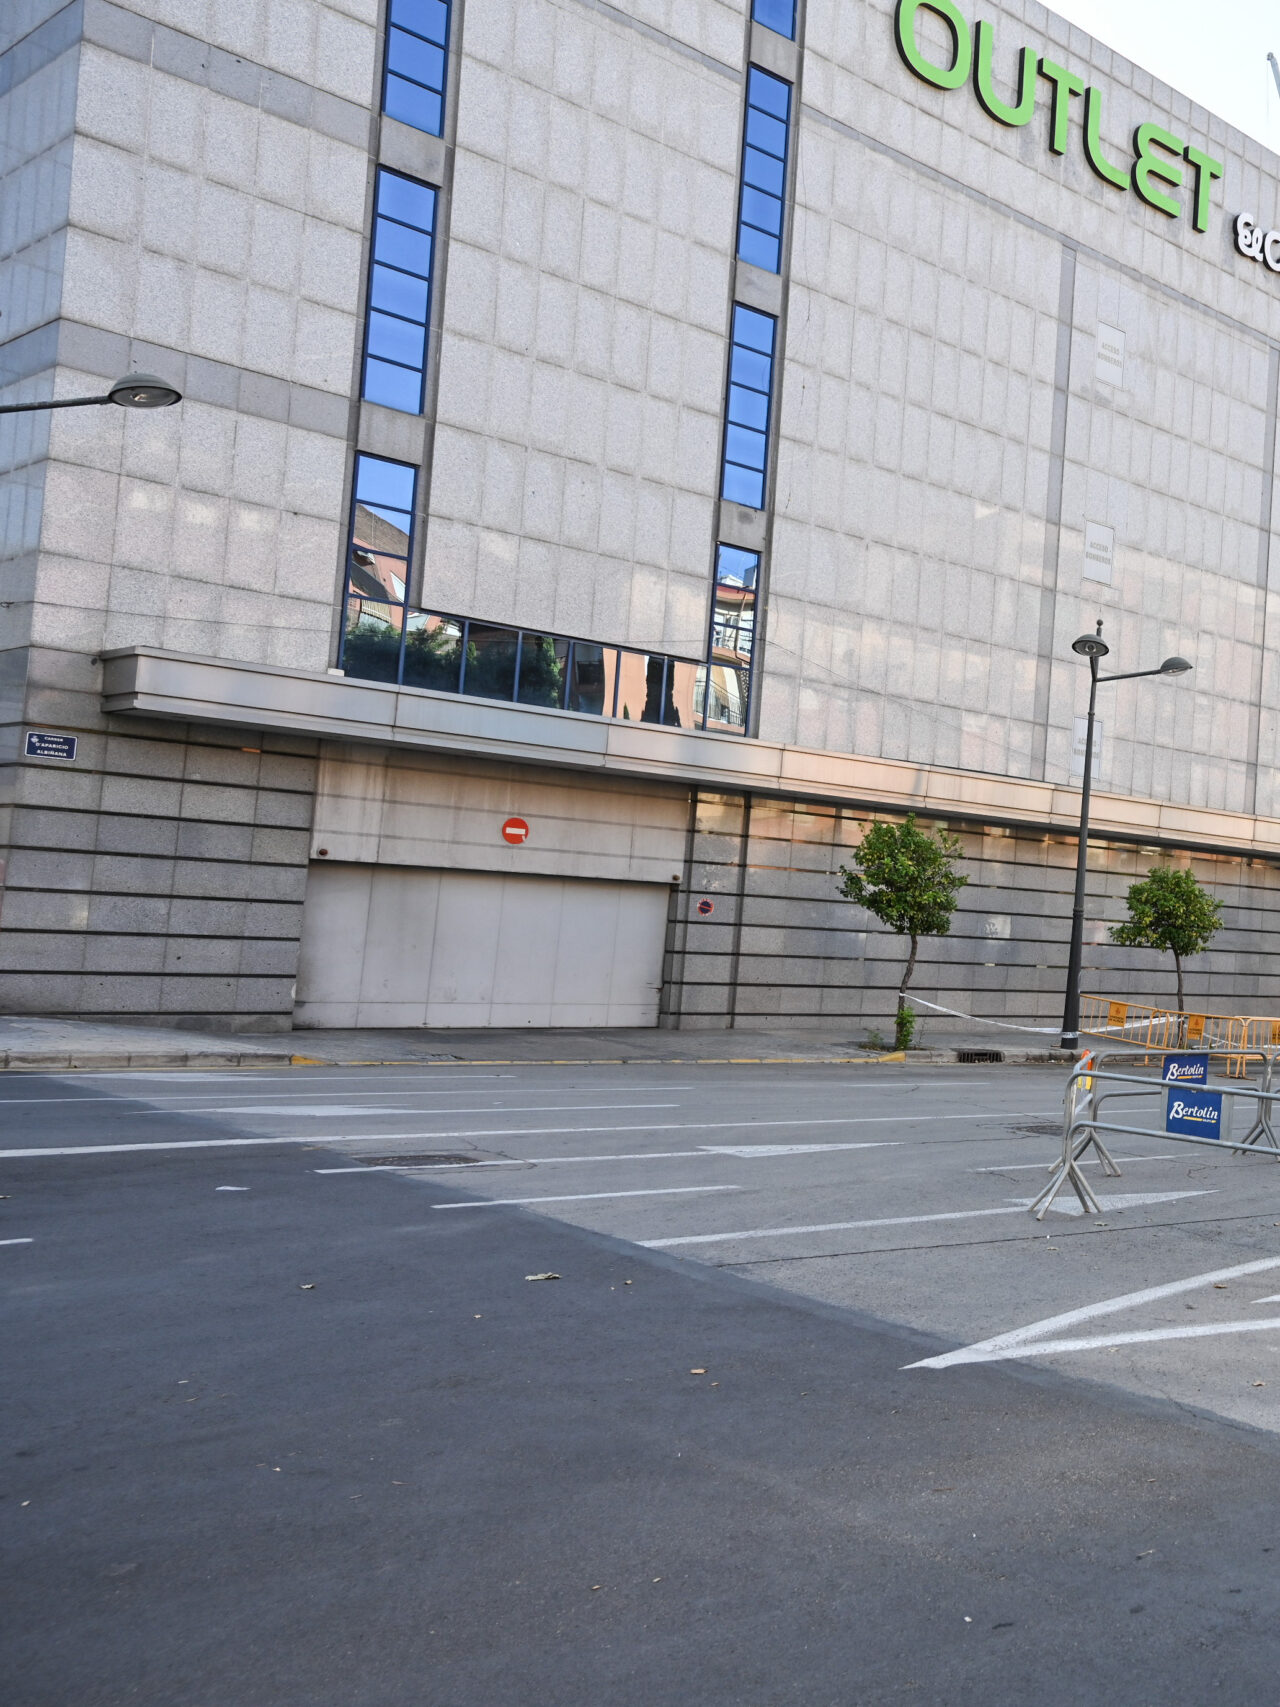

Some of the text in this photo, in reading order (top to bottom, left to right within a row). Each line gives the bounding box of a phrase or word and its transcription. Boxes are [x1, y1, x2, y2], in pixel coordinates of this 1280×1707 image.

[894, 0, 1223, 233] OUTLET
[1233, 212, 1263, 262] El
[1166, 1063, 1204, 1081] Bertolín
[1169, 1101, 1219, 1120] Bertolín
